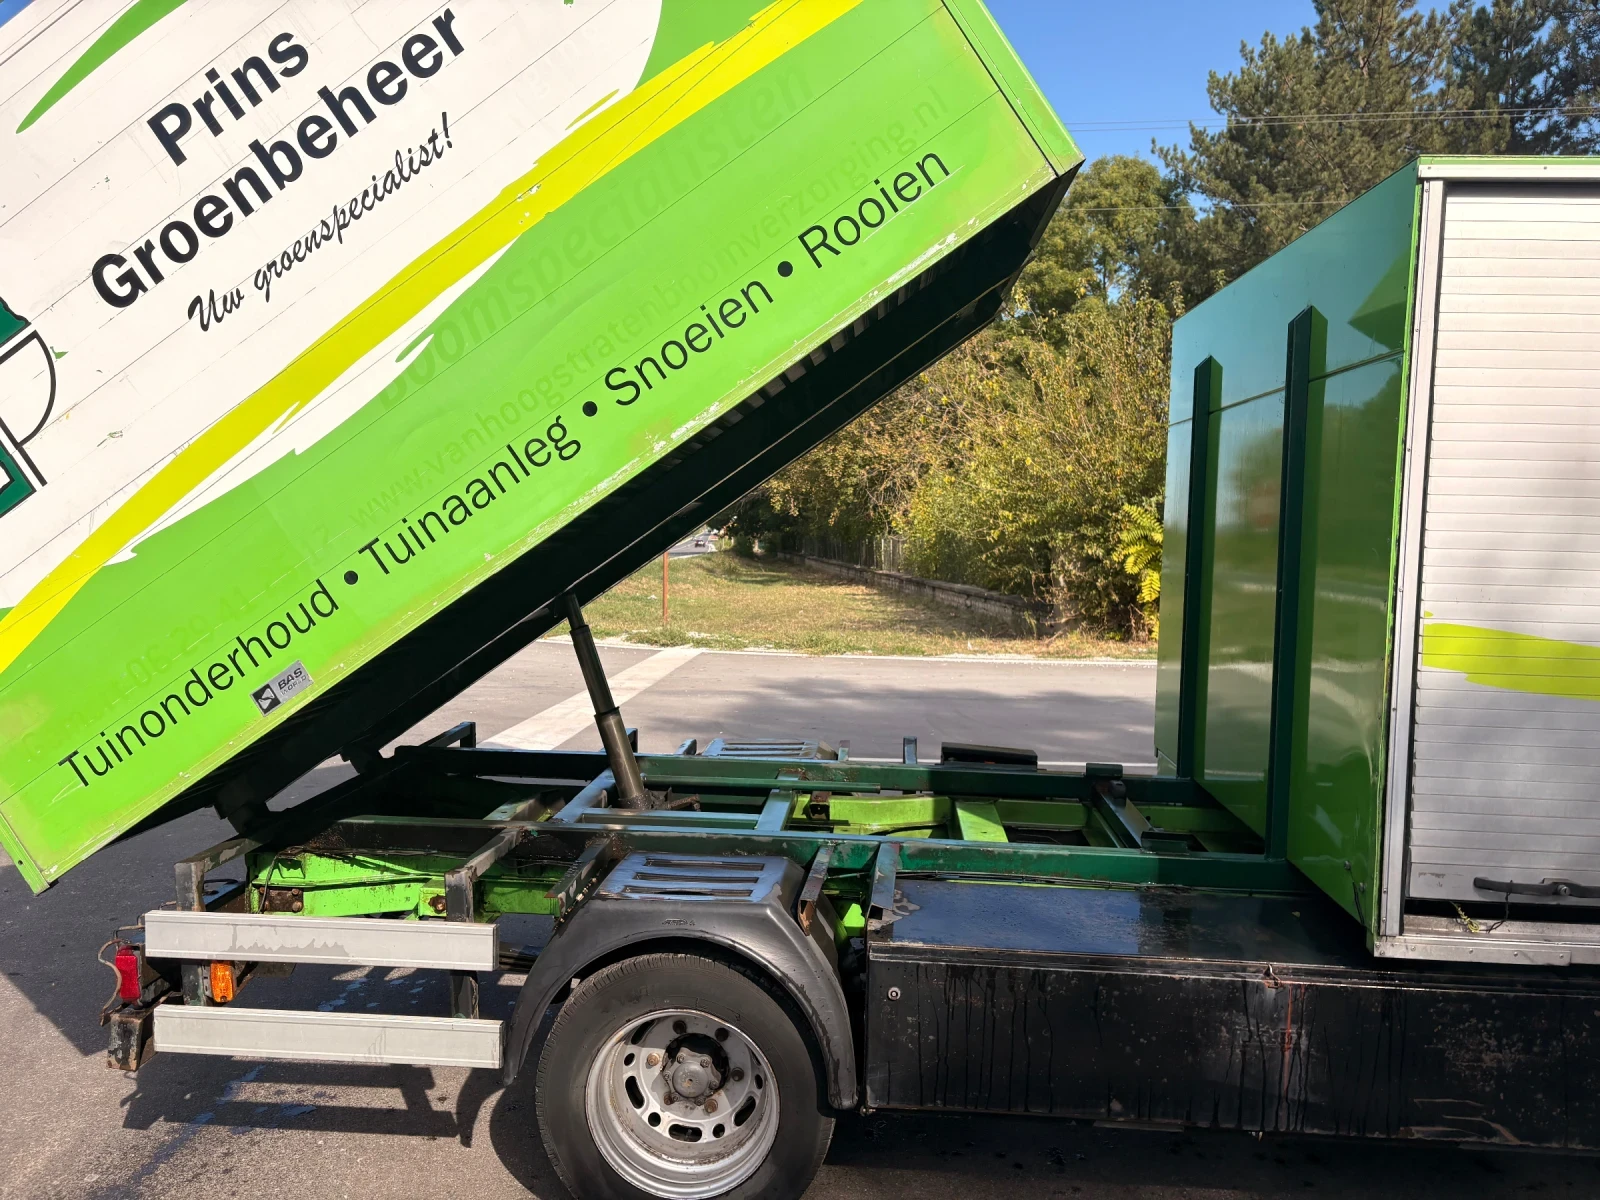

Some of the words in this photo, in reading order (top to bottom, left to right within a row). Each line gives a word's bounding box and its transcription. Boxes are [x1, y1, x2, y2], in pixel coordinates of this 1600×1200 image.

[91, 7, 465, 308] Groenbeheer
[147, 31, 309, 167] Prins
[187, 288, 245, 332] Uw
[253, 111, 453, 303] groenspecialist!
[57, 578, 339, 788] Tuinonderhoud
[357, 415, 581, 575] Tuinaanleg
[604, 281, 774, 406] Snoeien
[798, 153, 950, 269] Rooien
[277, 667, 303, 691] BAS
